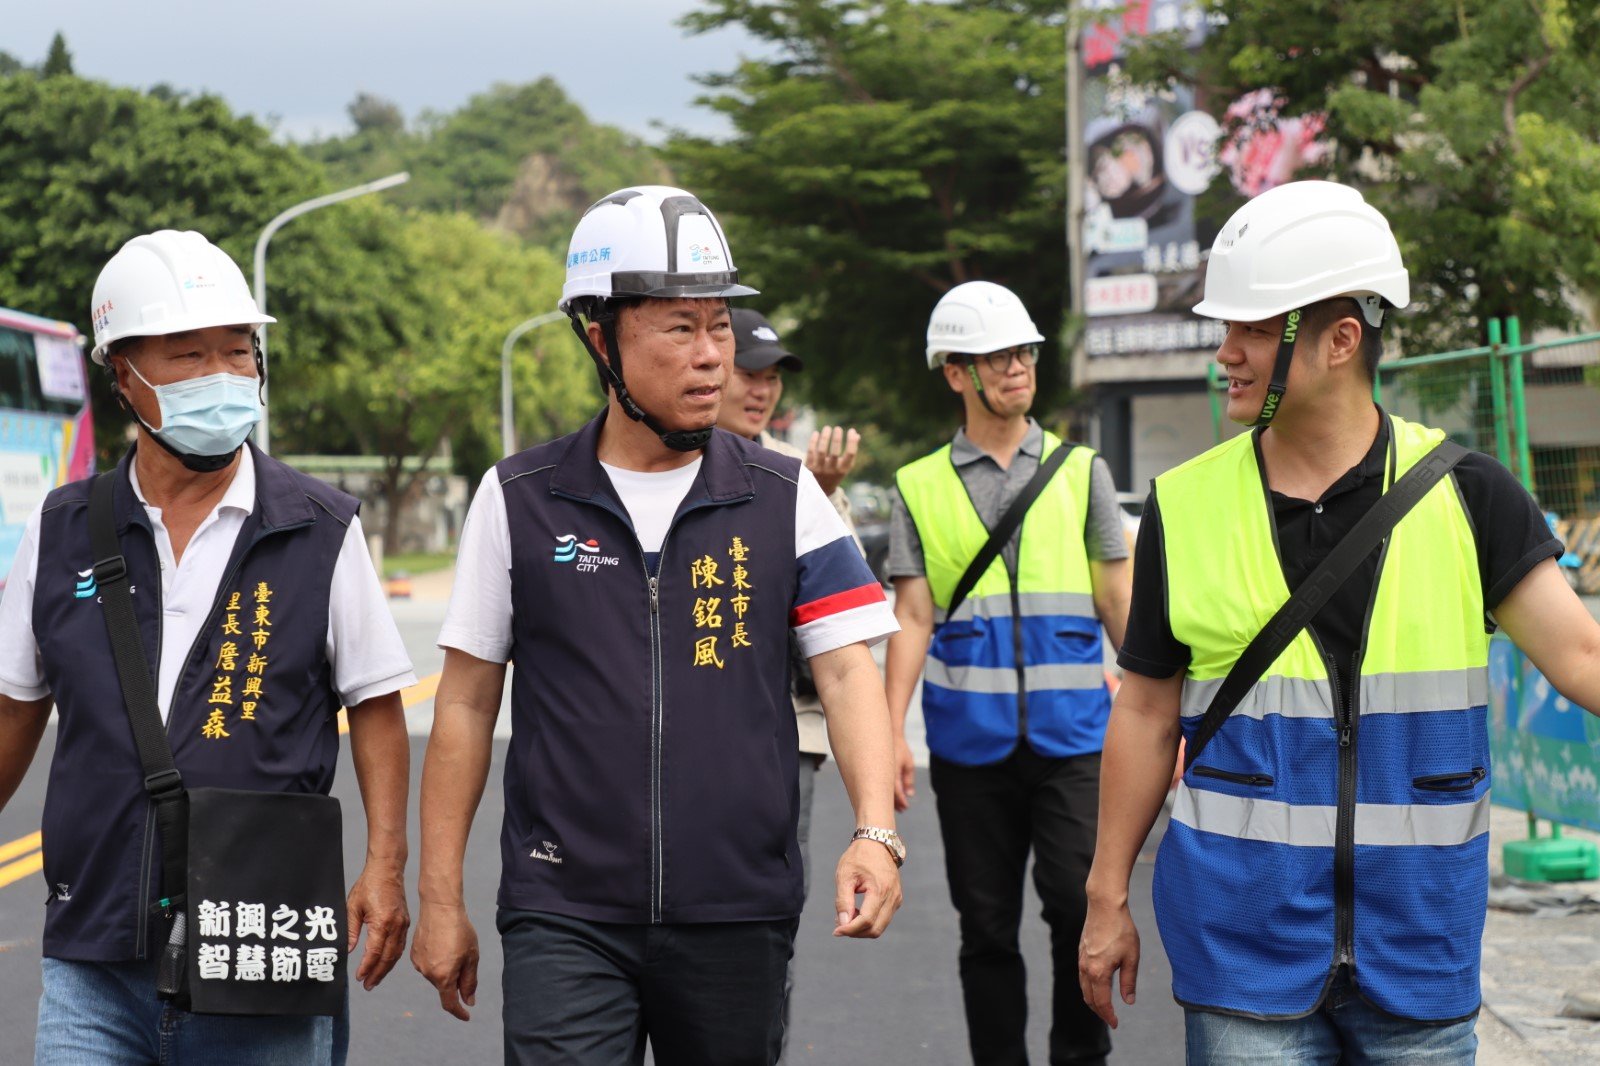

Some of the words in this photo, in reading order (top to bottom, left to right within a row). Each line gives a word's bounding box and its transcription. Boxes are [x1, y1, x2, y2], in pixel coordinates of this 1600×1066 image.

[1284, 309, 1300, 343] uve
[1261, 392, 1281, 418] uve
[576, 563, 599, 573] CITY
[577, 554, 620, 566] TAITUNG
[728, 535, 752, 648] 臺東市長
[691, 554, 725, 669] 陳銘風
[240, 581, 273, 721] 臺東市新興里
[198, 899, 338, 941] 新興之光
[198, 943, 338, 982] 智慧節電
